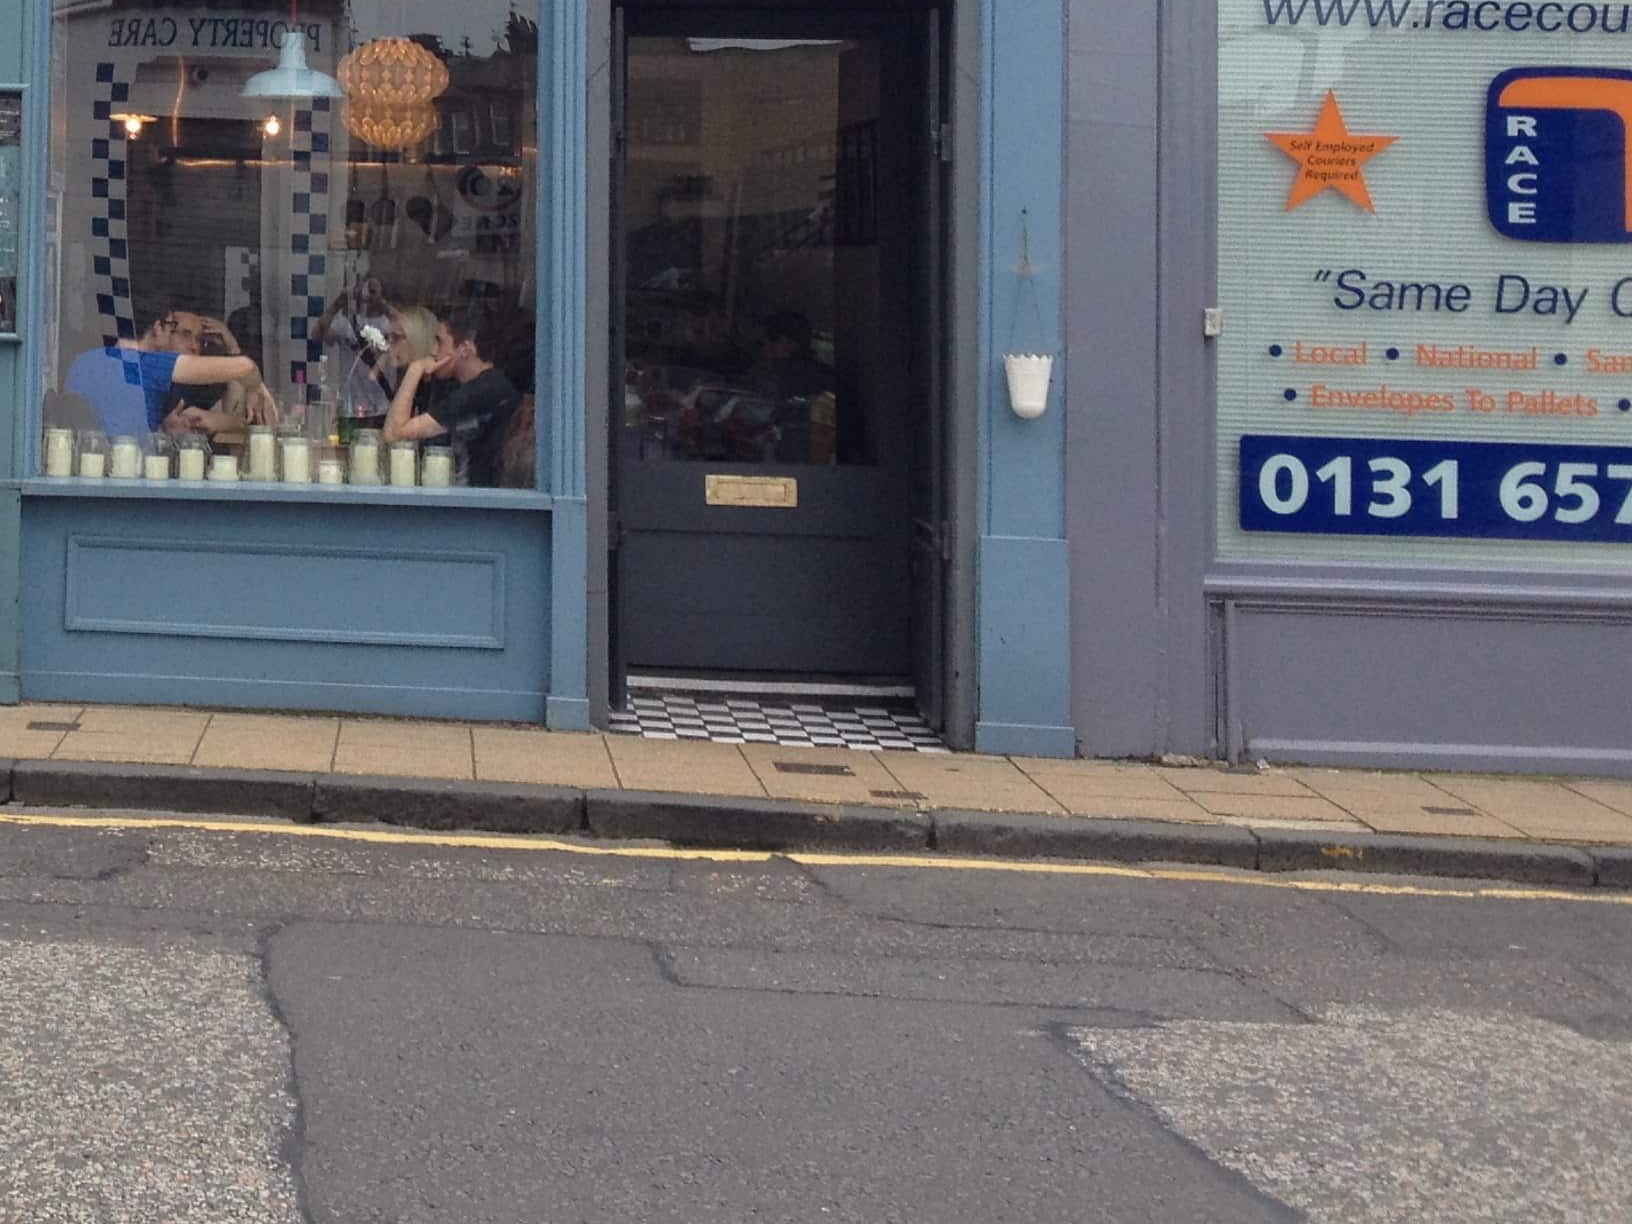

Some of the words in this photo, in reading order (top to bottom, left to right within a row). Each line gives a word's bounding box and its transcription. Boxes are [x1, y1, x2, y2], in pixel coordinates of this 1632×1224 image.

[1506, 116, 1538, 224] RACE
[1495, 275, 1589, 325] Day
[1295, 340, 1368, 365] Local
[1416, 344, 1538, 370] National
[1312, 384, 1456, 417] Envelopes
[1465, 388, 1497, 413] To
[1508, 390, 1598, 416] Pallets
[1258, 454, 1459, 520] 0131
